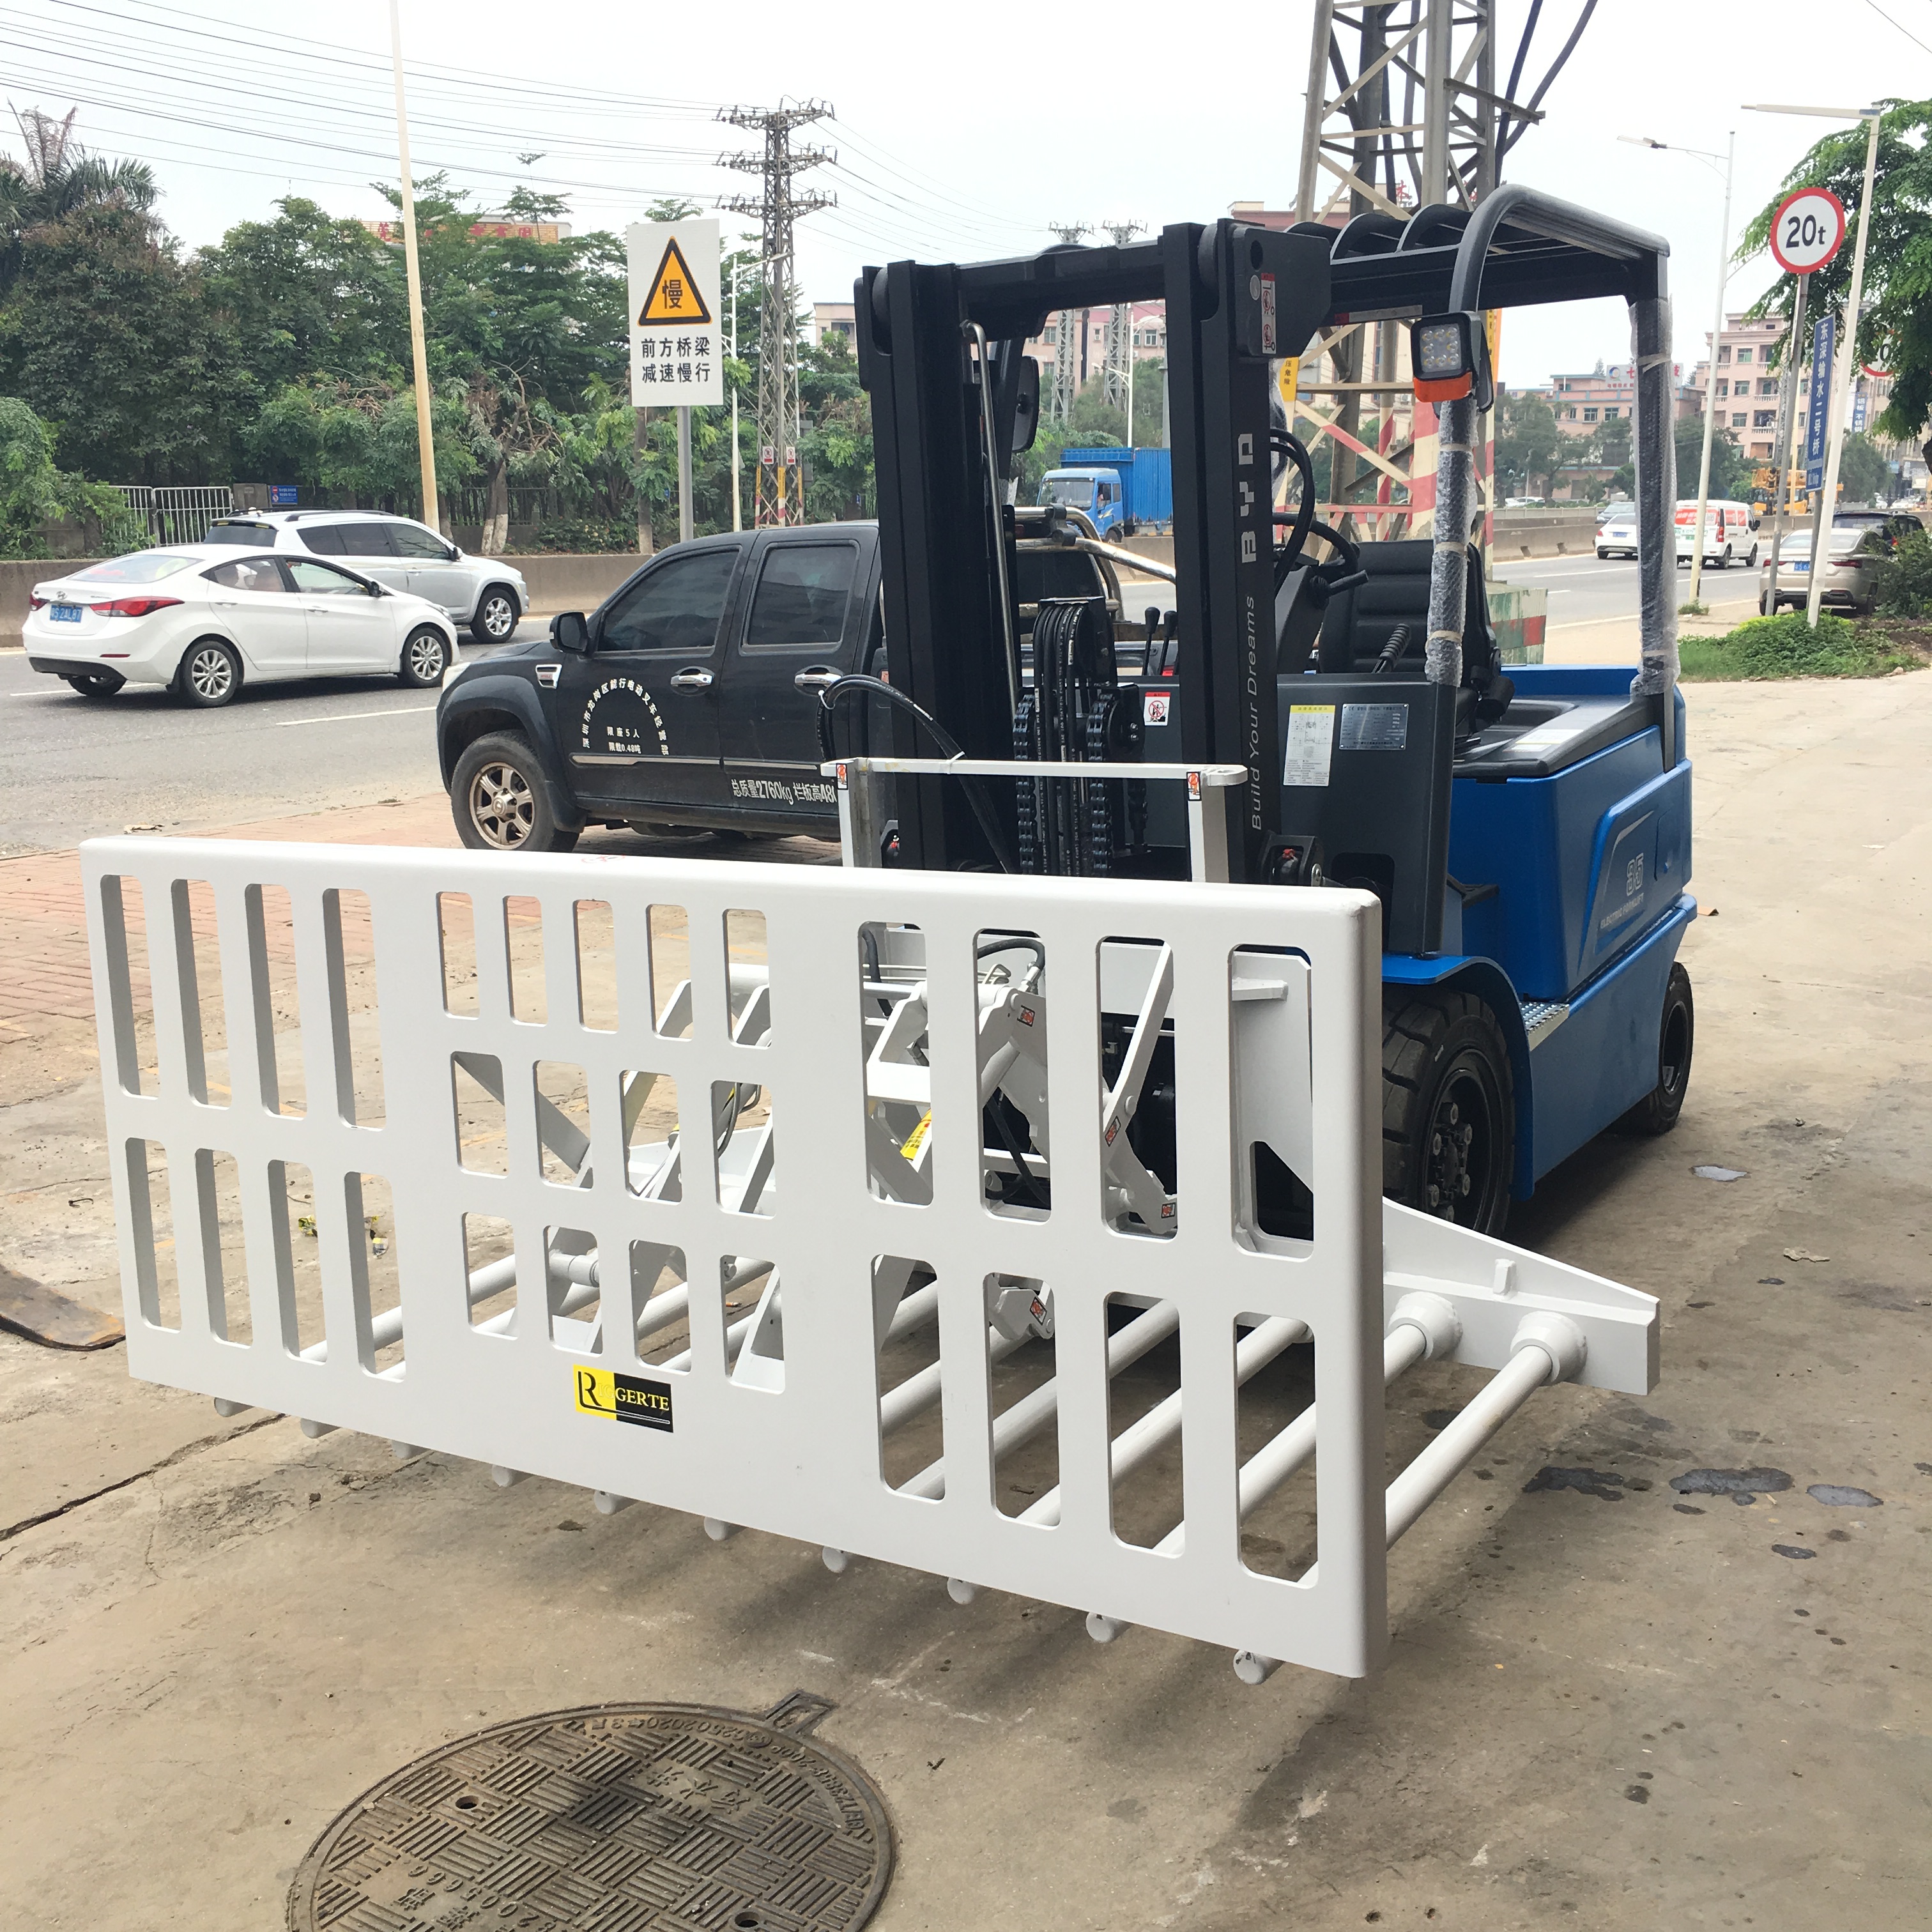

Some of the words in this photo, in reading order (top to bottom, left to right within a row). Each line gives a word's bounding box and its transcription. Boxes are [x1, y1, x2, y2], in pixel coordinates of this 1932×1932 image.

[1786, 215, 1826, 249] 20t
[663, 280, 683, 309] 慢
[641, 337, 710, 358] 前方桥梁
[642, 362, 710, 383] 减速慢行
[1813, 323, 1828, 456] 东深输水二号桥
[1238, 434, 1257, 563] BYD
[1246, 595, 1257, 696] Dreams
[1249, 702, 1259, 760] Your
[731, 779, 794, 805] 总质量2760kg
[1250, 767, 1262, 831] Build
